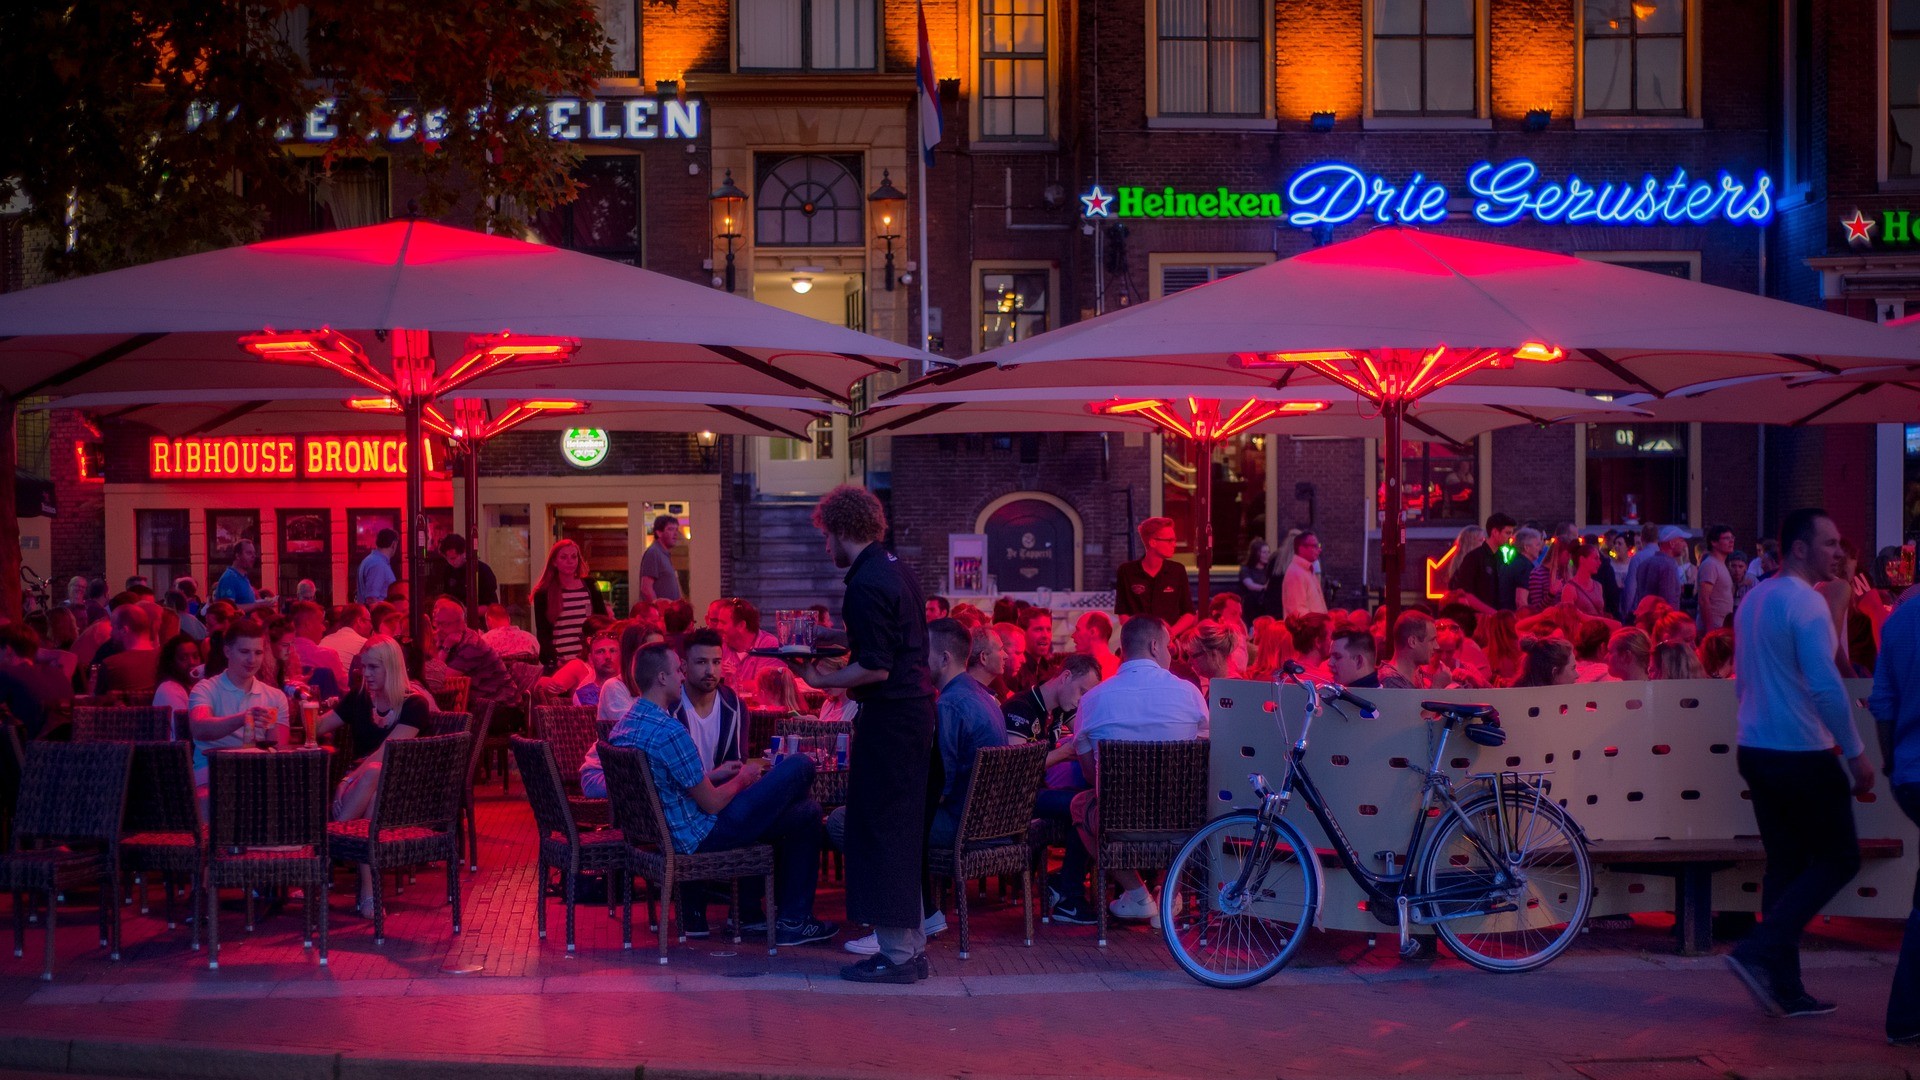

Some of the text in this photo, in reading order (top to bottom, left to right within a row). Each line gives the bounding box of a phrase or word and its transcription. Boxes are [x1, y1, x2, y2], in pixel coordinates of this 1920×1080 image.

[1117, 186, 1283, 218] Heineken
[1287, 161, 1771, 225] Drie Gezusters
[153, 441, 294, 473] RIBHOUSE
[802, 924, 819, 937] N
